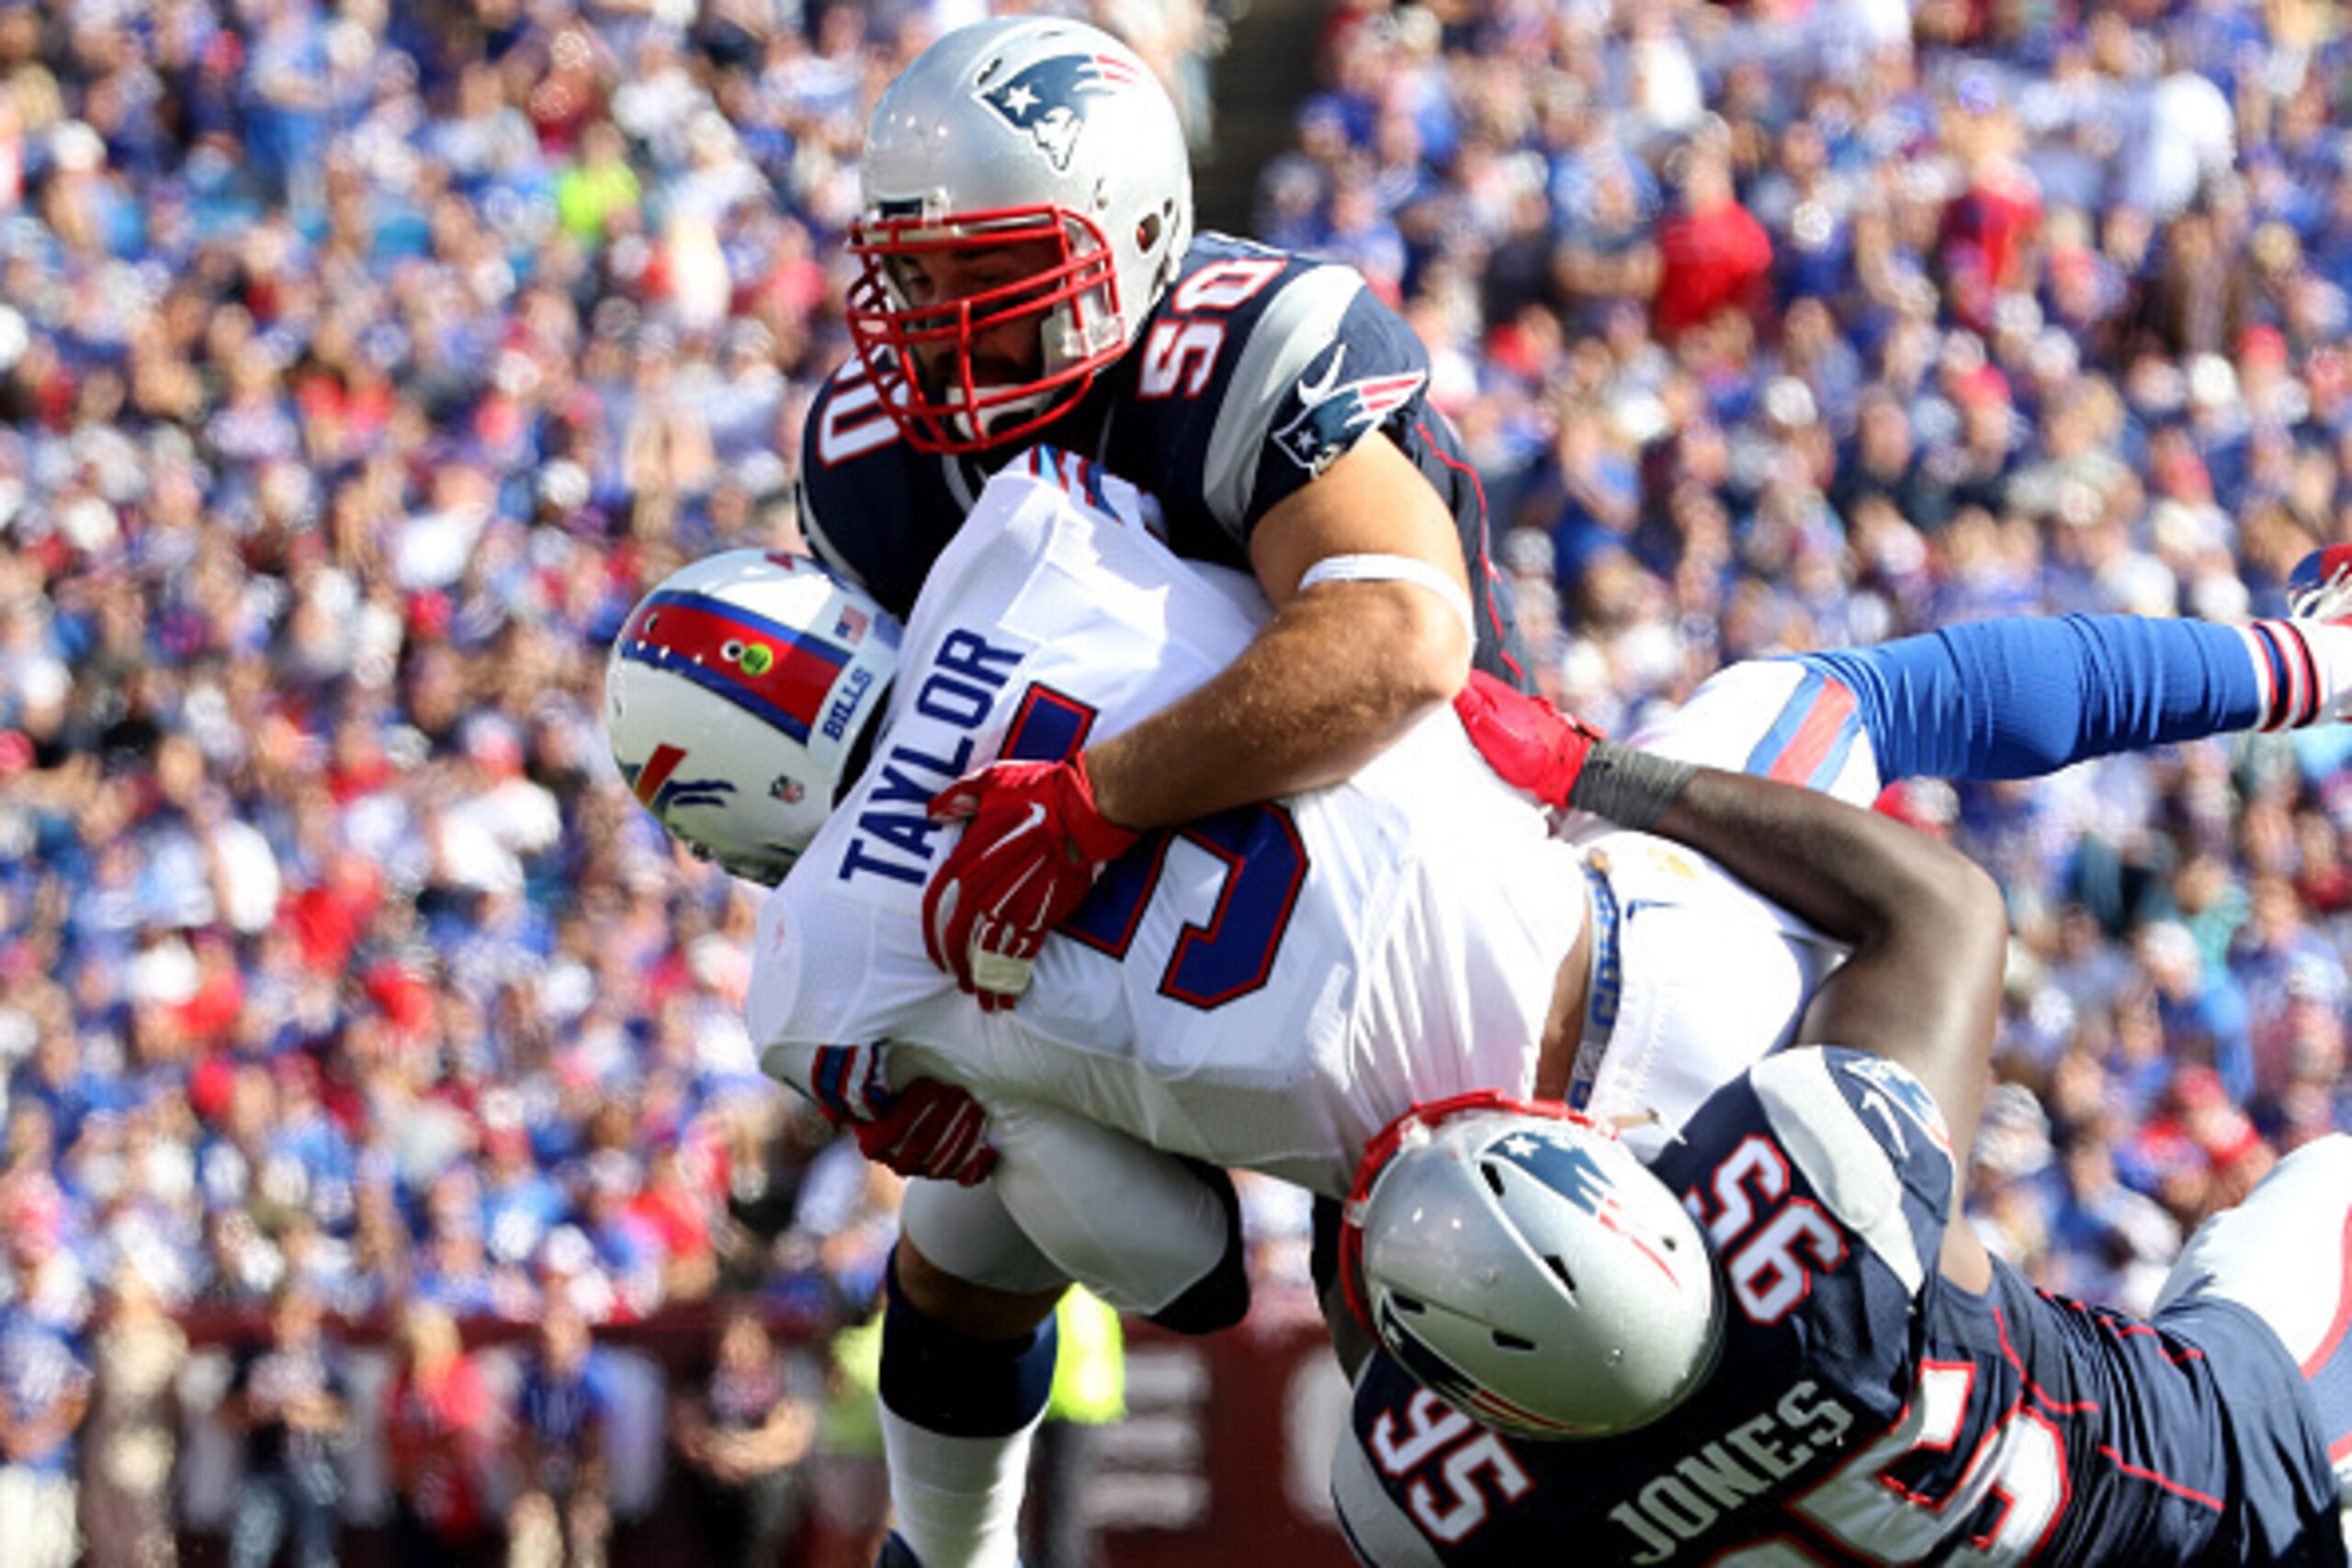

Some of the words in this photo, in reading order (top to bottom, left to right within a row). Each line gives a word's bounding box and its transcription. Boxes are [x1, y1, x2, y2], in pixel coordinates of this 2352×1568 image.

[1136, 257, 1286, 400] 50
[822, 666, 876, 742] BILLS
[838, 627, 1026, 887] TAYLOR
[1606, 1380, 1854, 1565] JONES
